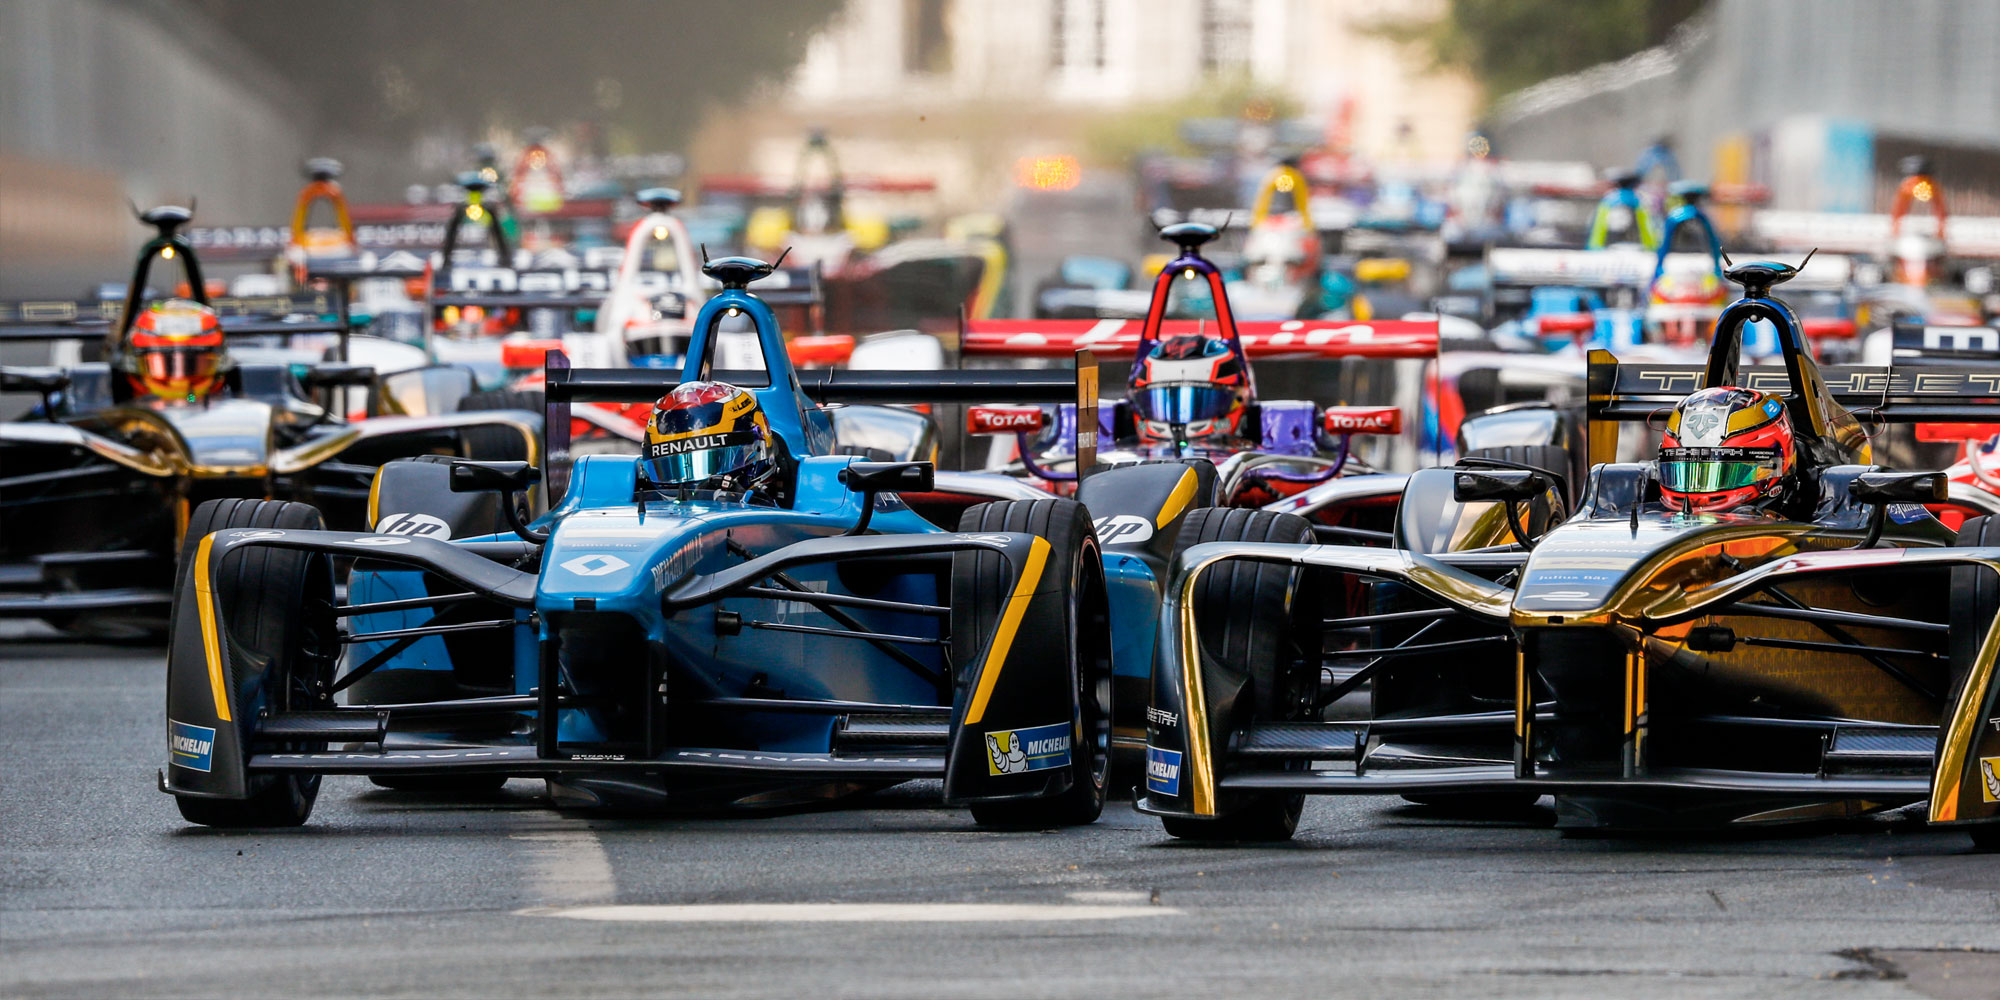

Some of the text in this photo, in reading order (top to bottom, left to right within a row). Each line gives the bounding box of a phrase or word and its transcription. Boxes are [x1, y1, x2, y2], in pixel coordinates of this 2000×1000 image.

[983, 412, 1037, 426] TOTAL
[1330, 414, 1387, 428] TOTAL
[652, 433, 728, 457] RENAULT
[383, 513, 443, 536] hp
